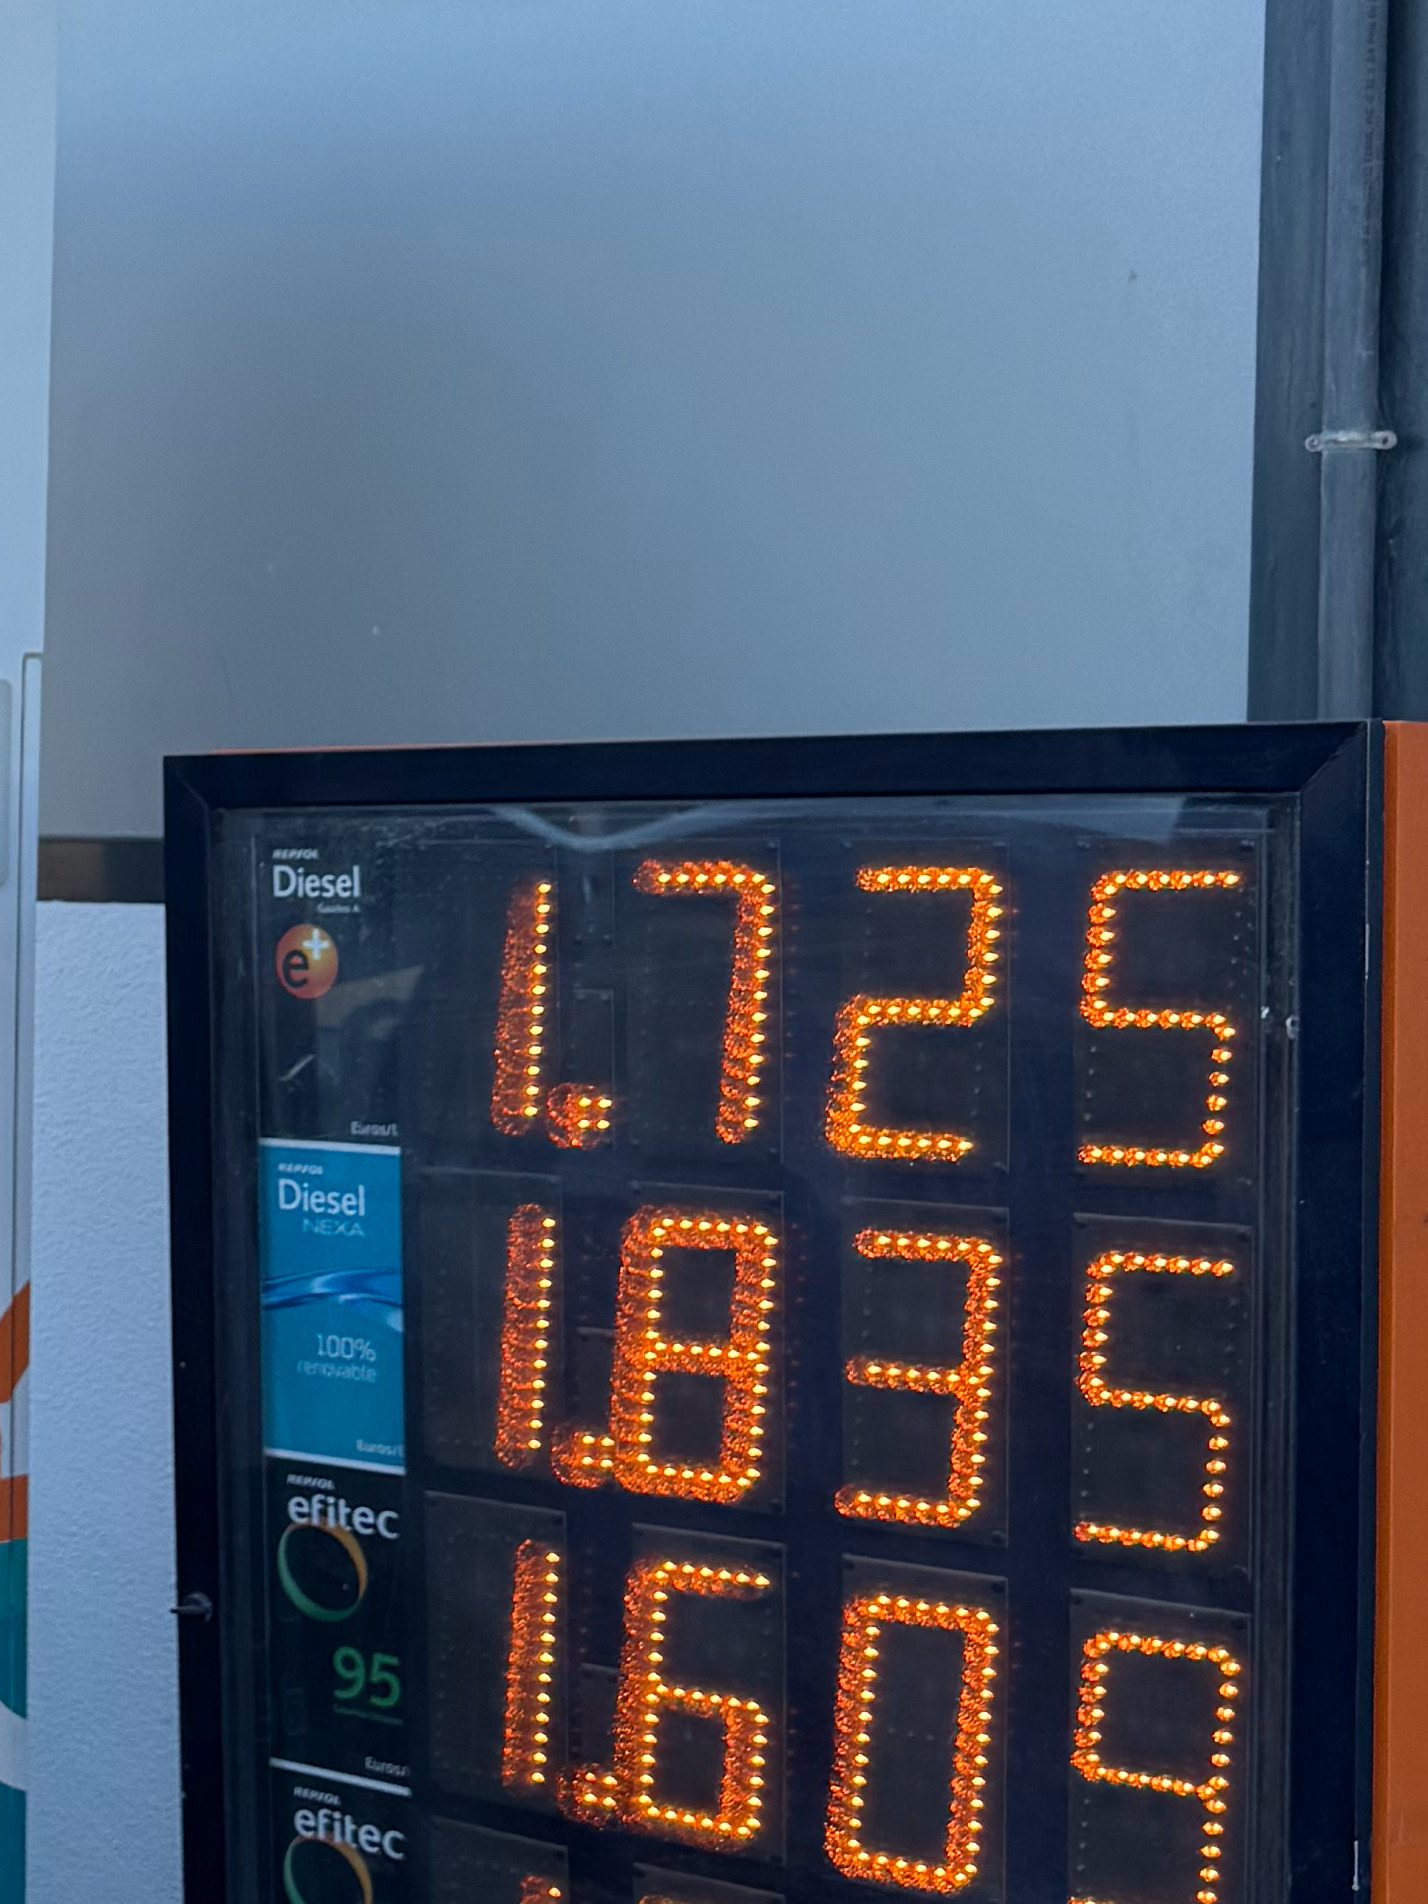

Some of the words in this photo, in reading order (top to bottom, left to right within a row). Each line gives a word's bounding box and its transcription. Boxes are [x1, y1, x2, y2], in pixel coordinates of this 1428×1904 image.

[273, 865, 360, 898] Diesel
[490, 859, 1242, 1169] 1.725
[279, 1179, 366, 1216] Diesel
[302, 1218, 366, 1237] NEXA
[316, 1334, 376, 1362] 100%
[494, 1202, 1236, 1553] 1.835
[288, 1493, 401, 1540] efitec
[333, 1646, 401, 1708] 95
[294, 1808, 407, 1860] efitec
